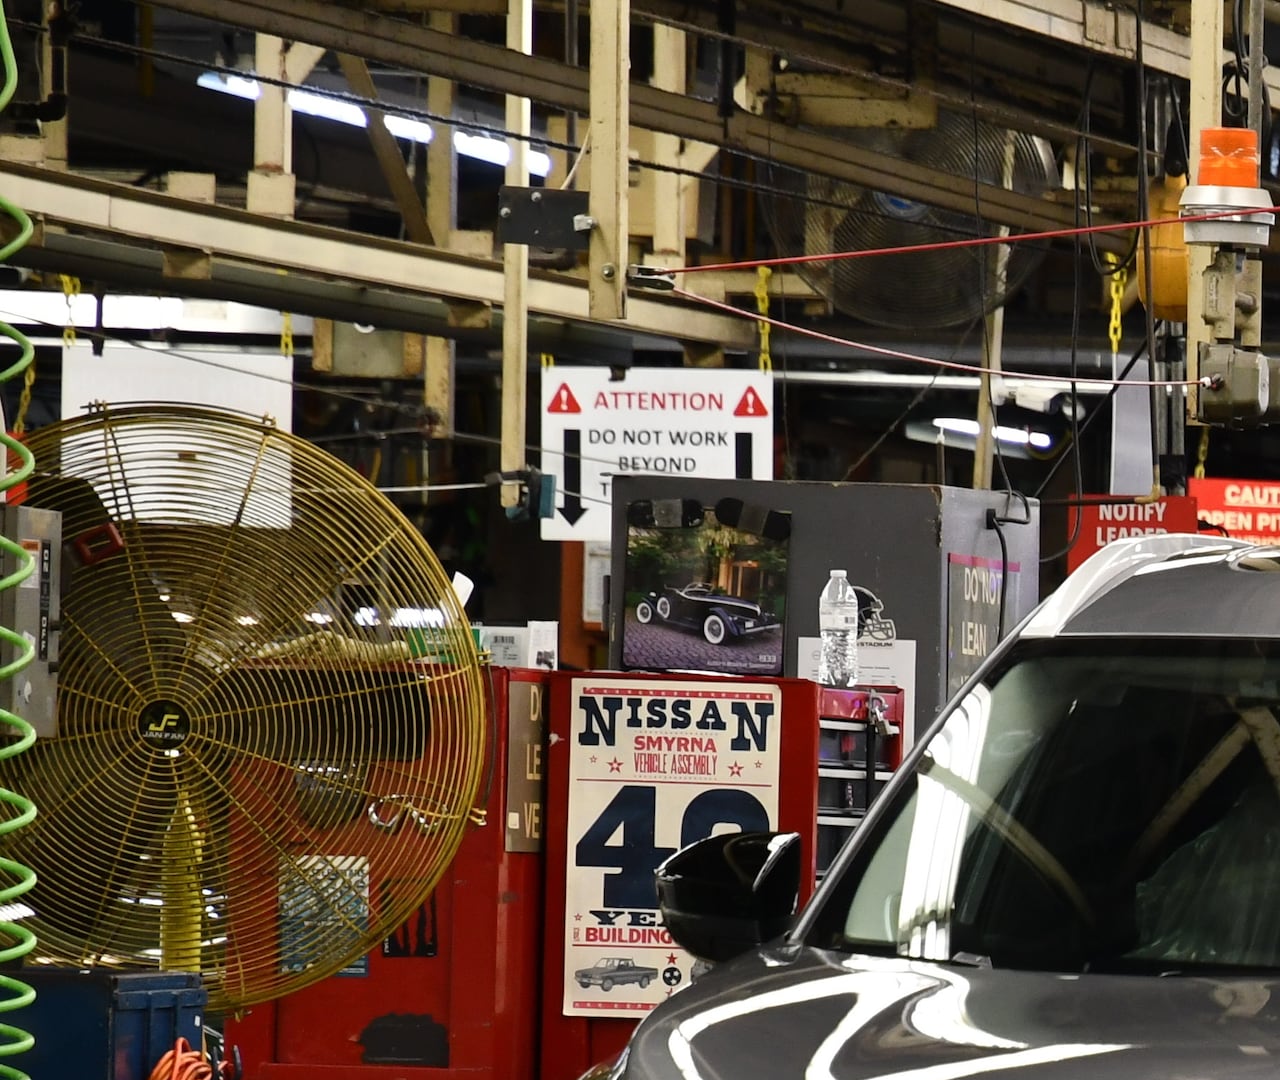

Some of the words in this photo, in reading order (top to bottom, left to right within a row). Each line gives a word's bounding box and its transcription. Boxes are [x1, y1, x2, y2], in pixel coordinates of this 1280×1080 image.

[594, 391, 723, 411] ATTENTION
[588, 428, 616, 445] DO
[623, 430, 662, 446] NOT
[668, 431, 728, 447] WORK
[619, 456, 697, 472] BEYOND
[1098, 502, 1168, 522] NOTIFY
[964, 567, 979, 602] DO
[982, 571, 1003, 606] NOT
[961, 620, 987, 657] LEAN
[578, 696, 775, 752] NISSAN
[634, 735, 717, 753] SMYRNA
[633, 752, 668, 774] VEHICLE
[670, 754, 718, 776] ASSEMBLY
[585, 926, 673, 944] BUILDING
